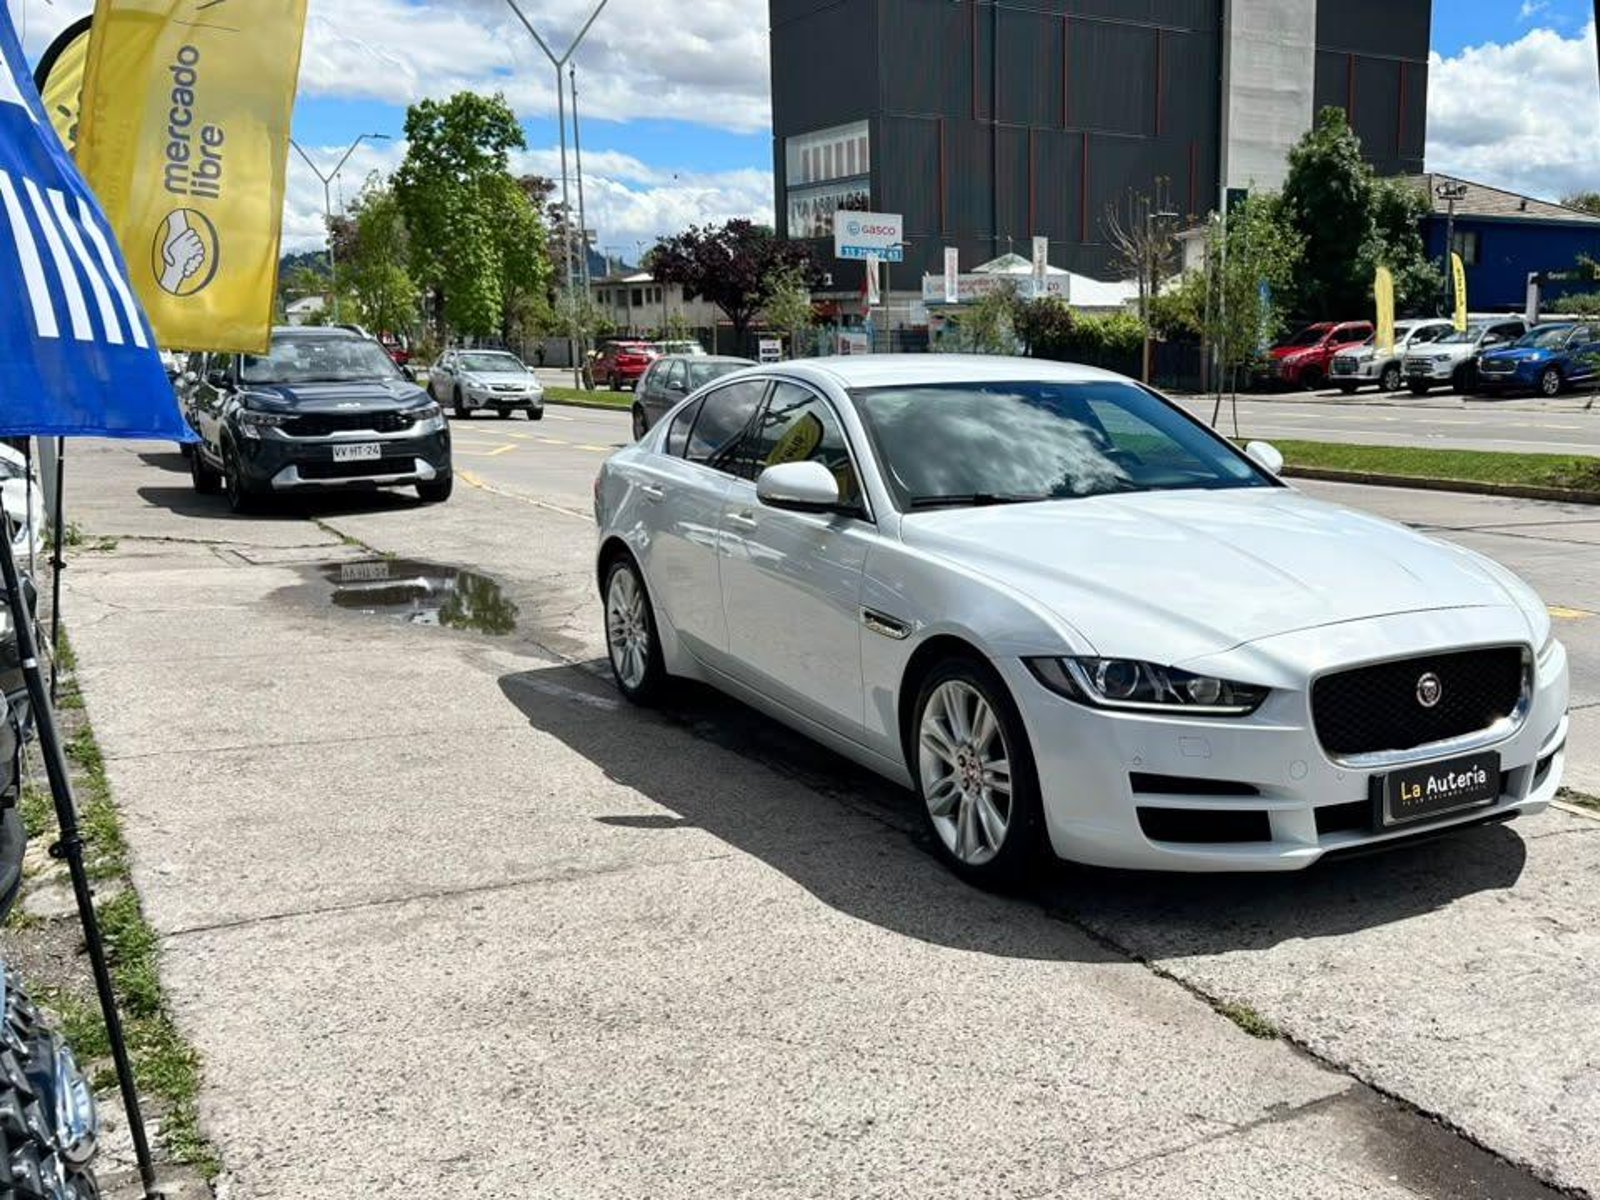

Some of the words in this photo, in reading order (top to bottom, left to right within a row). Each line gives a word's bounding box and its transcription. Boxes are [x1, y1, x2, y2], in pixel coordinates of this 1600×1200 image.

[164, 44, 200, 195] mercado
[190, 125, 225, 199] libre
[1400, 781, 1421, 801] La
